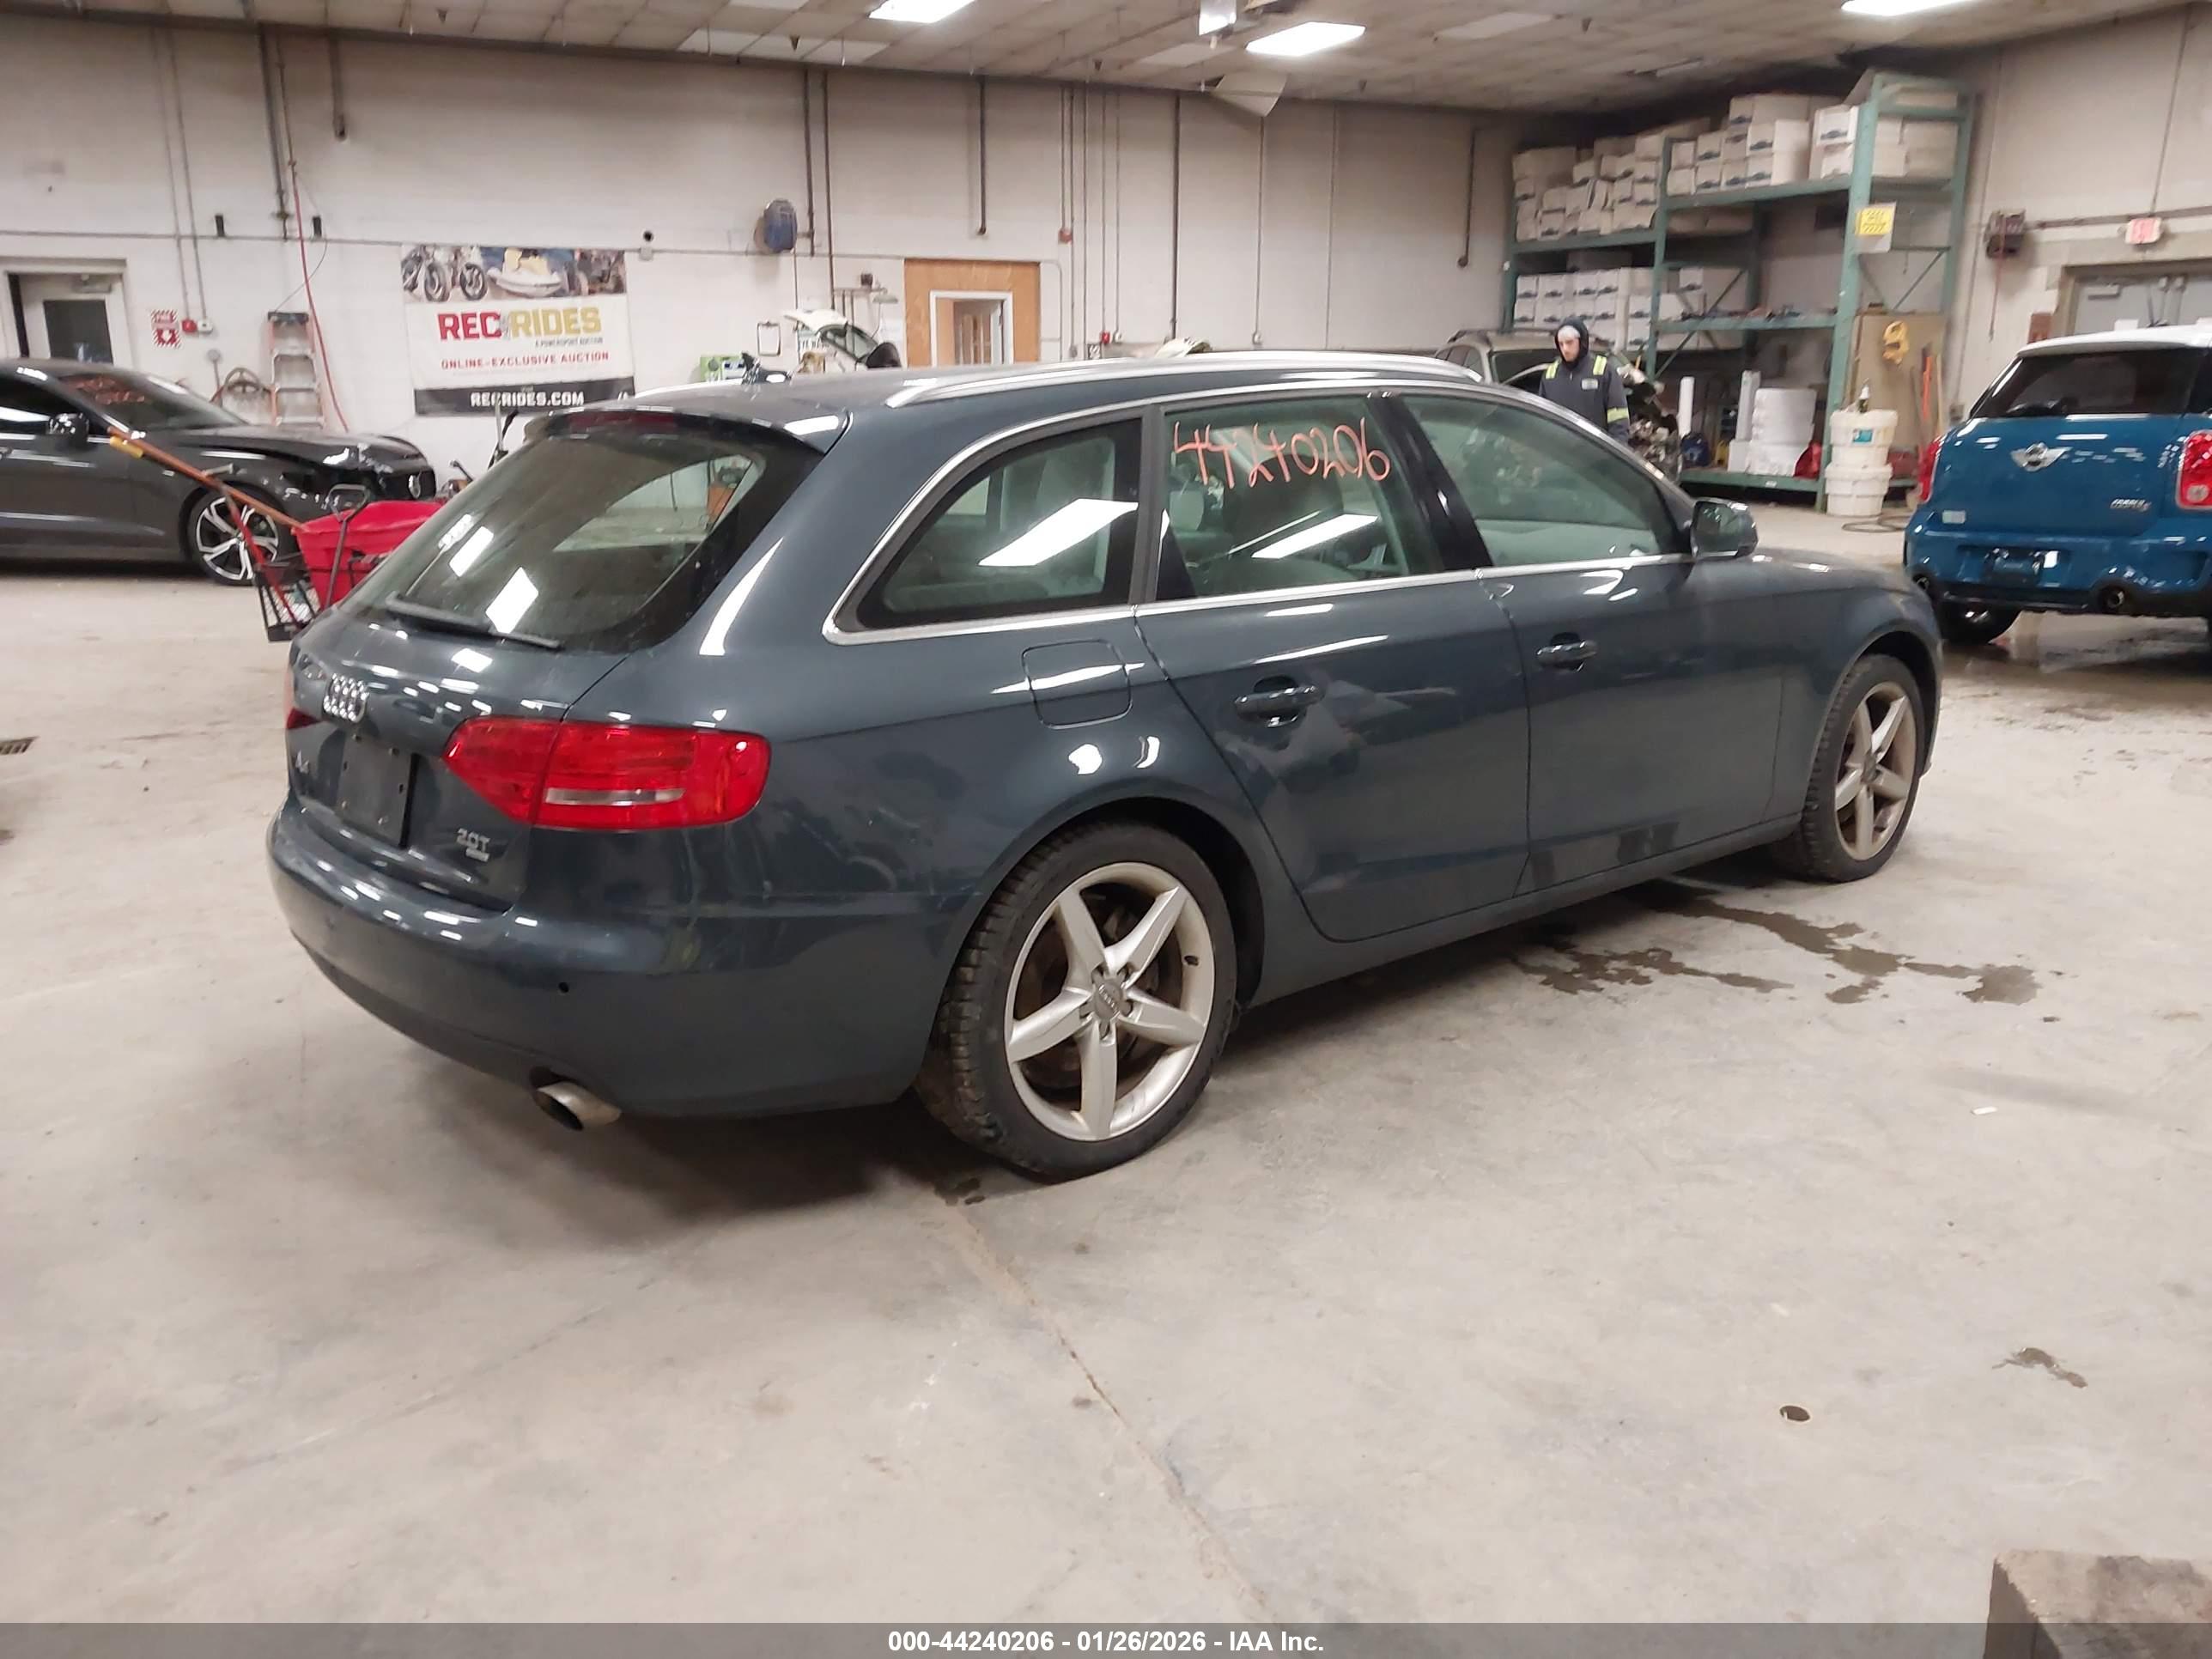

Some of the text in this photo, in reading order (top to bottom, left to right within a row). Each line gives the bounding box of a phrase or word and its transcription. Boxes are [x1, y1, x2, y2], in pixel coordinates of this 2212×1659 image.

[510, 307, 601, 337] RIDES
[561, 351, 610, 363] AUCTION
[471, 392, 584, 407] RECRIDES.COM
[1173, 416, 1391, 489] 44240206
